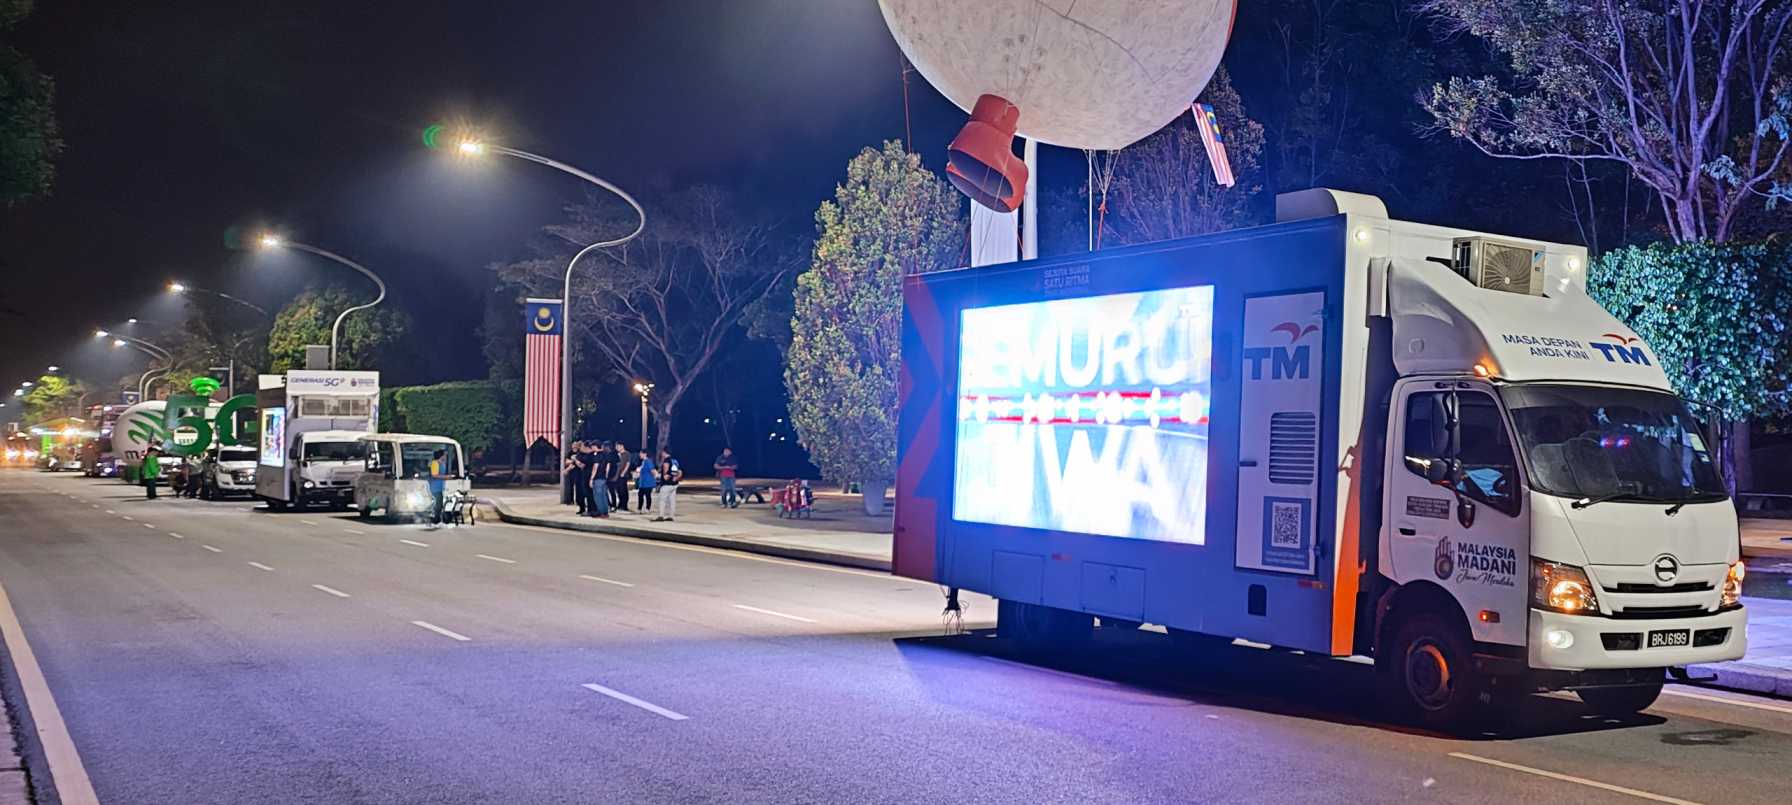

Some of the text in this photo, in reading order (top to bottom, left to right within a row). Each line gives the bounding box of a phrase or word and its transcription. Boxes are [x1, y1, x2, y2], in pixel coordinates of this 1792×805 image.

[1502, 334, 1582, 349] MASA DEPAN
[1244, 345, 1310, 380] TM
[1530, 347, 1590, 360] ANDA KINI
[1589, 342, 1651, 366] TM
[323, 377, 340, 387] 5G
[1458, 543, 1516, 561] MALAYSIA
[1458, 554, 1516, 575] MADANI
